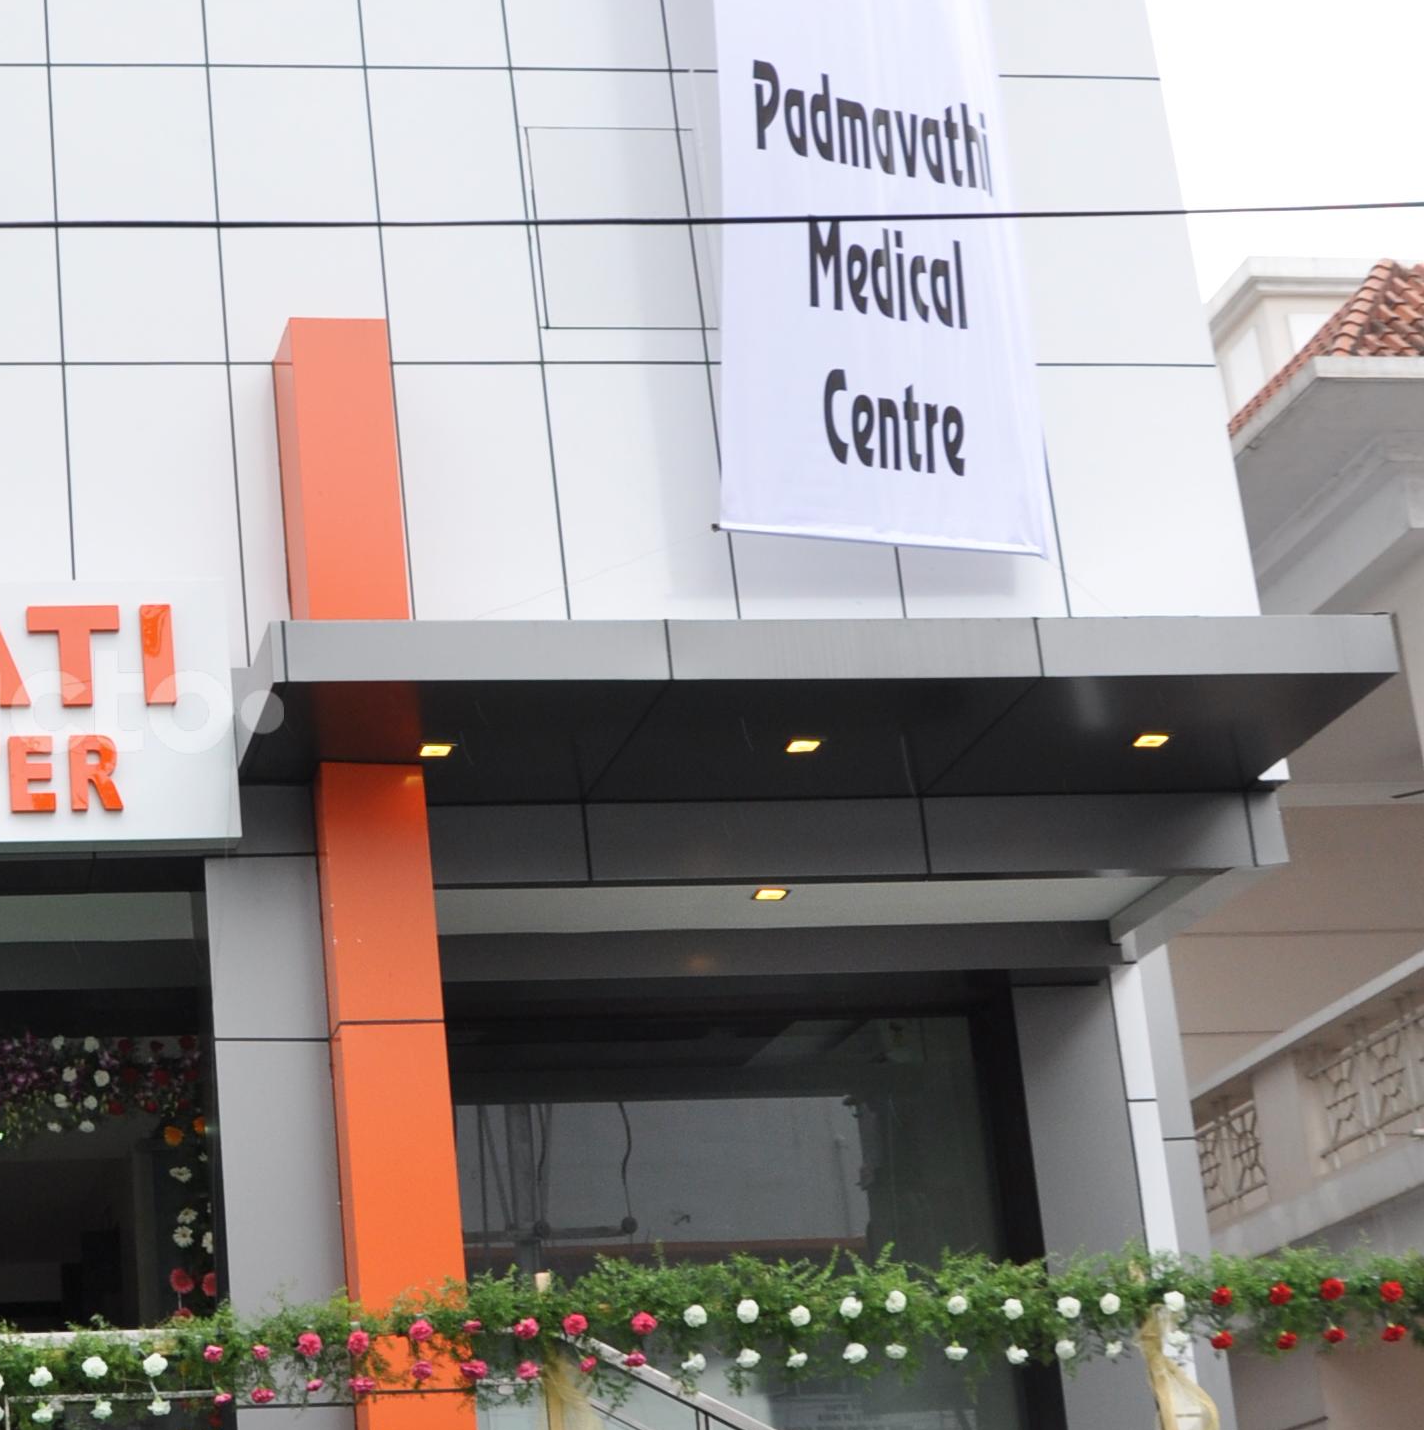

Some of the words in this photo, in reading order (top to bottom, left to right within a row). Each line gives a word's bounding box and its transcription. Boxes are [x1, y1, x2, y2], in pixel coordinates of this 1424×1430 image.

[752, 59, 994, 198] Padmavathi
[807, 215, 969, 330] Medical
[822, 368, 966, 477] Centre
